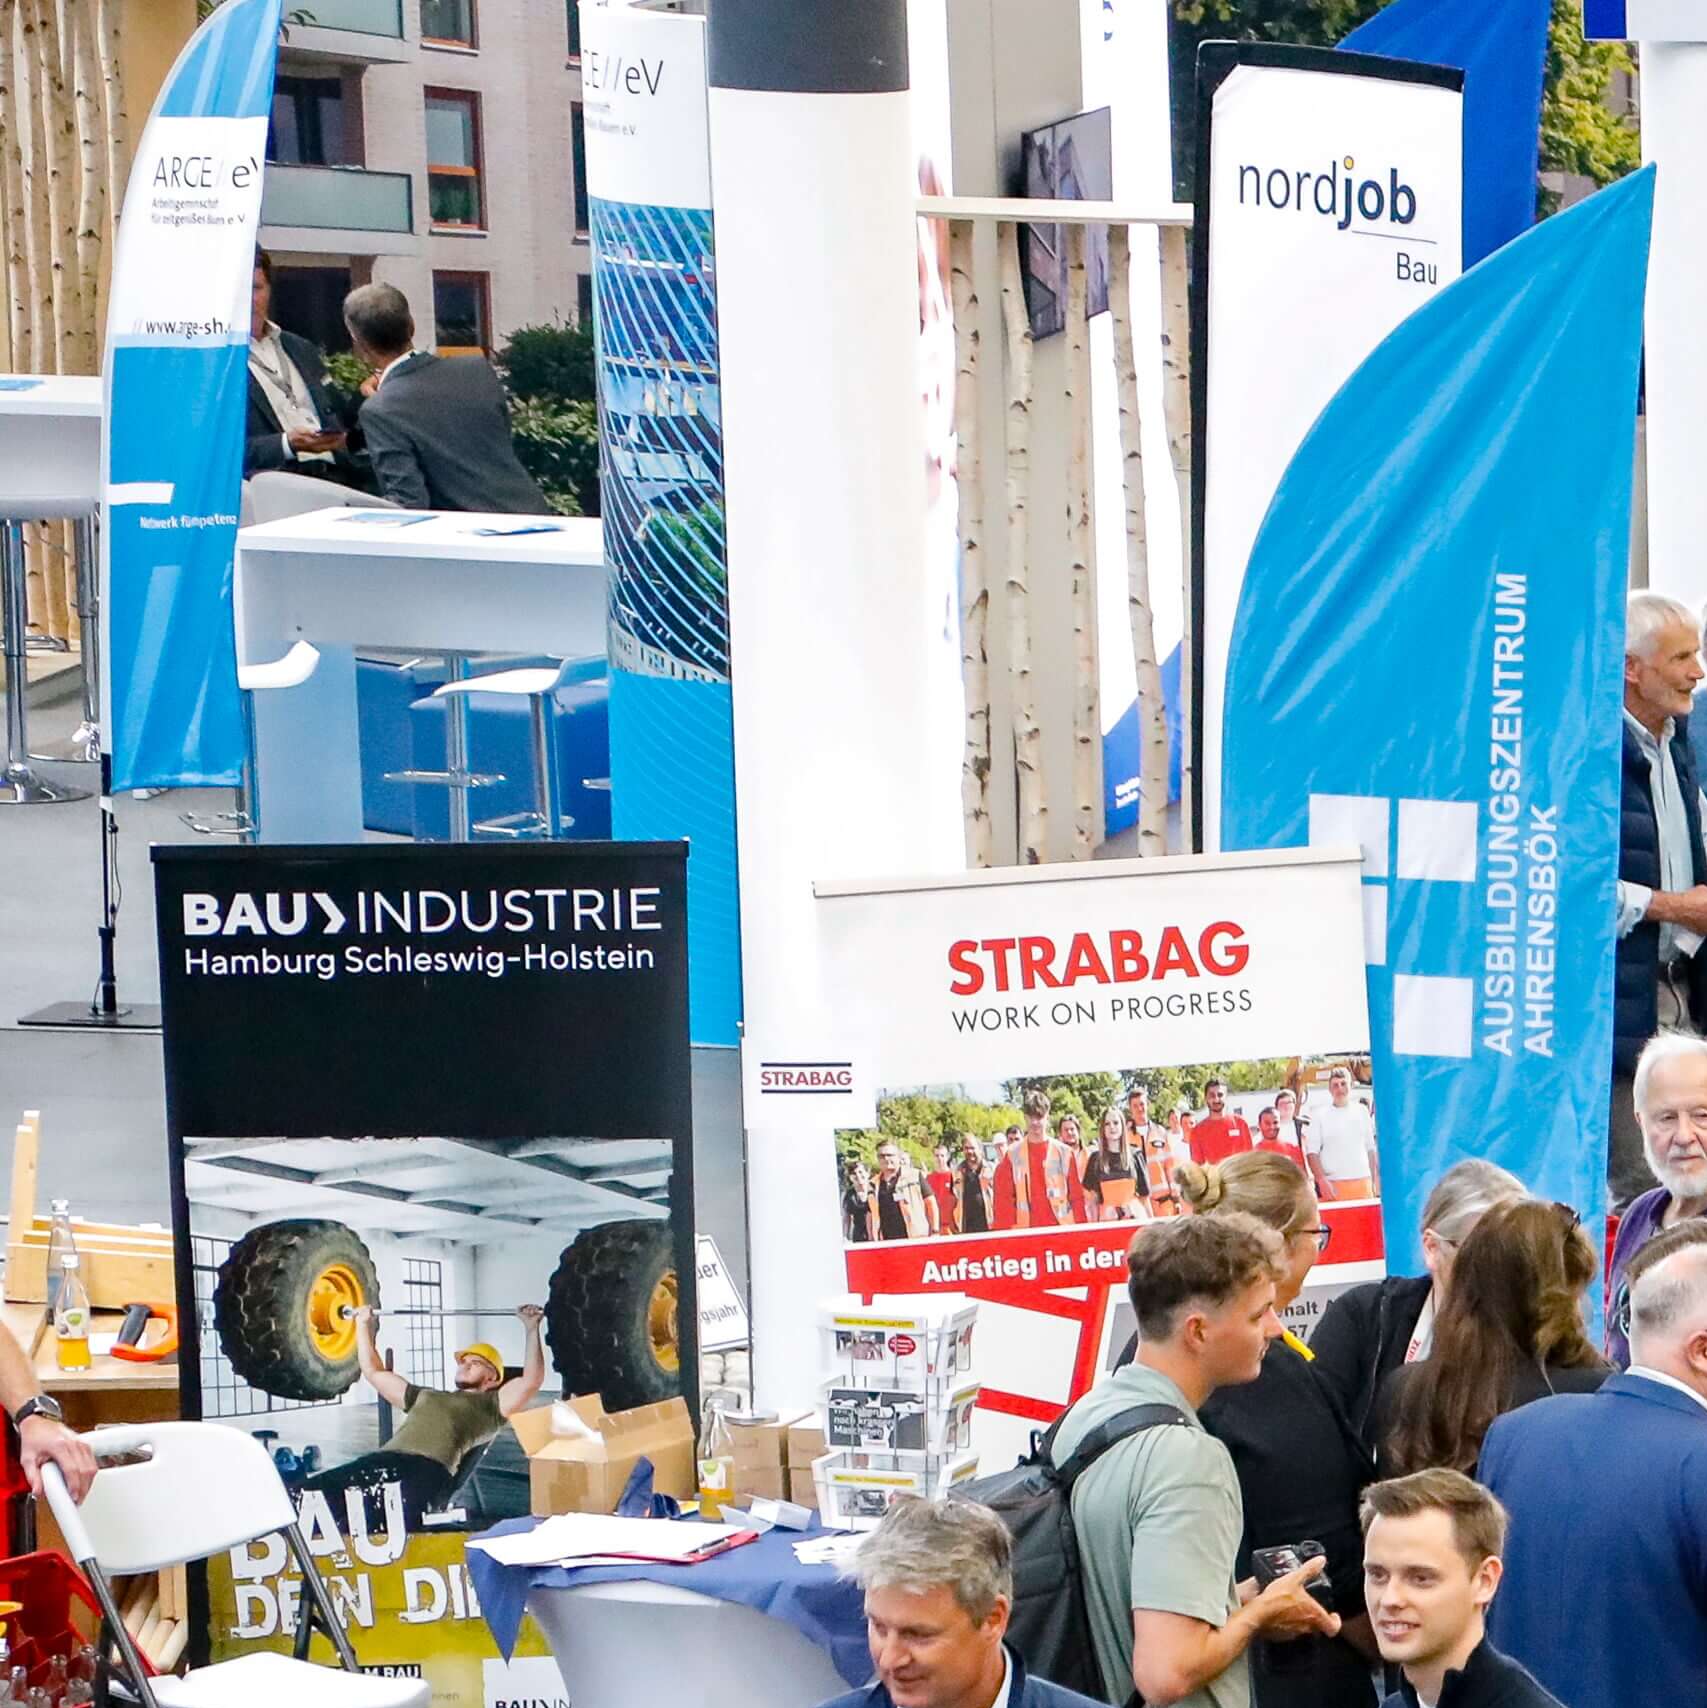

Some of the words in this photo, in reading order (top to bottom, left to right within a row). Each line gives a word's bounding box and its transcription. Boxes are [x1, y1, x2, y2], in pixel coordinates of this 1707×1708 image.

[1239, 155, 1417, 231] nordjob
[1397, 252, 1437, 285] Bau
[1483, 573, 1528, 1057] AUSBILDUNGSZENTRUM
[183, 893, 308, 936] BAU
[358, 887, 663, 934] INDUSTRIE
[1523, 804, 1560, 1058] AHRENSBÖK
[185, 947, 336, 980] Hamburg
[345, 943, 655, 978] Schleswig-Holstein
[947, 921, 1251, 996] STRABAG
[951, 1004, 1041, 1034] WORK
[1050, 1000, 1097, 1025] ON
[1111, 988, 1254, 1021] PROGRESS
[760, 1069, 853, 1088] STRABAG
[921, 1255, 1038, 1284] Aufstieg
[1045, 1250, 1073, 1273] in
[1079, 1247, 1126, 1270] der
